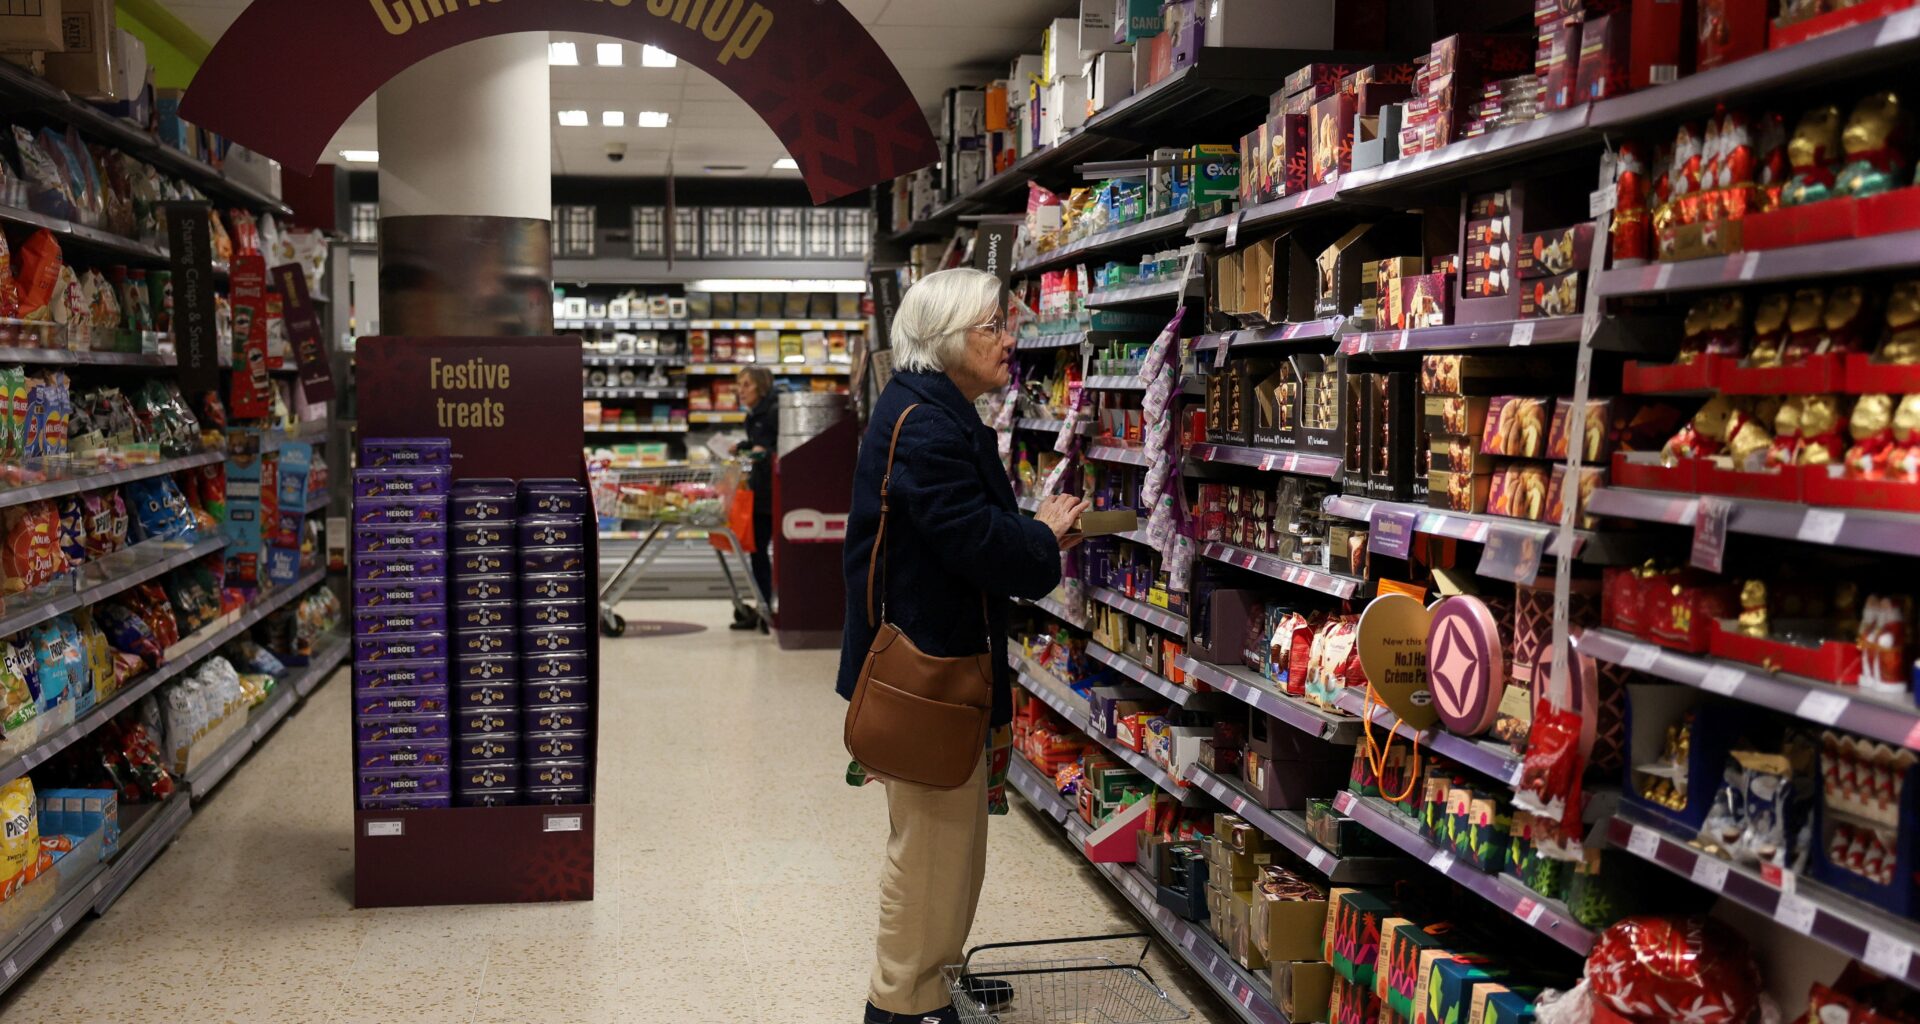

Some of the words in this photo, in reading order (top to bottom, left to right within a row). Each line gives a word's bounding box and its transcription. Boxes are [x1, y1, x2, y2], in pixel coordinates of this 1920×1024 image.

[181, 219, 194, 264] Sharing
[184, 268, 199, 308] Crisps
[188, 312, 201, 322] &
[190, 326, 203, 368] Snacks
[430, 357, 510, 390] Festive
[437, 397, 505, 428] treats
[392, 452, 419, 460] HEROES
[386, 482, 413, 490] HEROES
[386, 592, 414, 600] HEROES
[1395, 652, 1413, 667] No.1
[1384, 668, 1414, 684] Crème
[389, 726, 417, 734] HEROES
